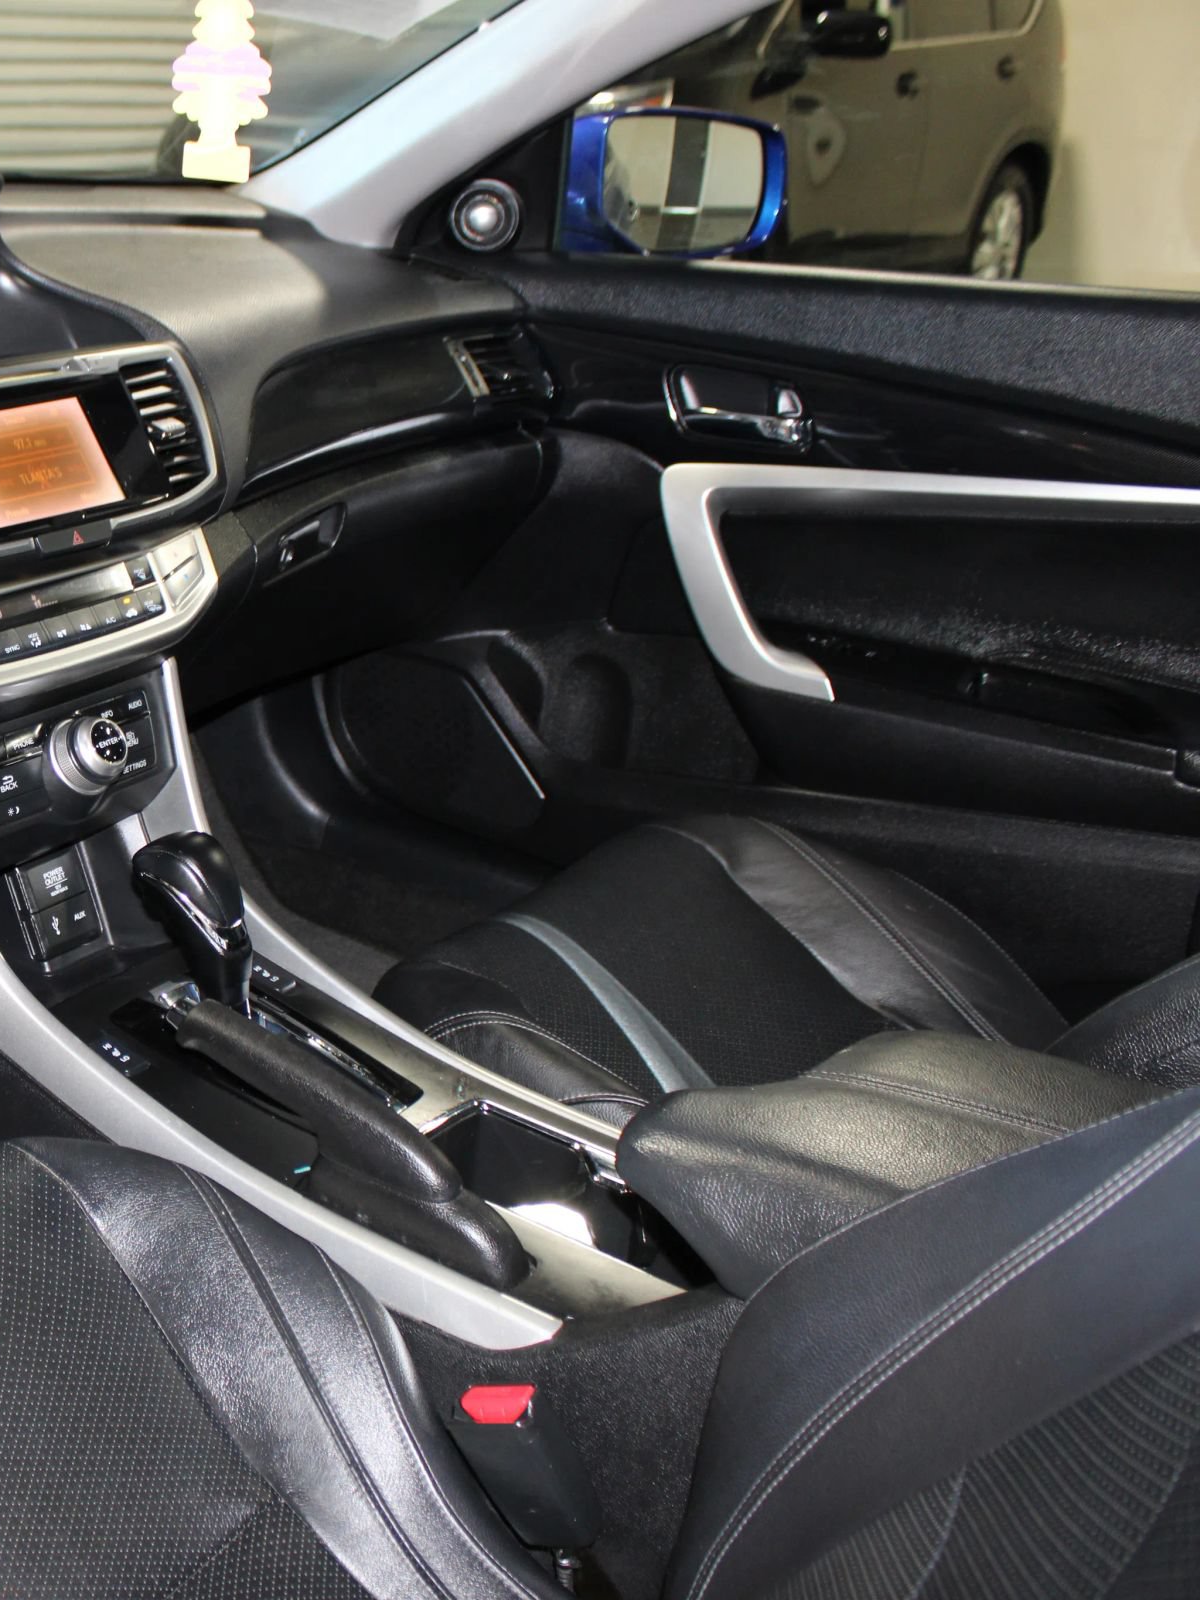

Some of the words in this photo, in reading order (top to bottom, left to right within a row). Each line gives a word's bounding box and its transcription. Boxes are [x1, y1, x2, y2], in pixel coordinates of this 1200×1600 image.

[4, 644, 21, 655] SYNC
[128, 699, 143, 711] AUDIO
[12, 737, 35, 751] PHONE
[99, 735, 119, 749] ENTER
[0, 781, 19, 794] BACK
[42, 866, 64, 880] POWER
[44, 872, 66, 887] OUTLET
[73, 910, 87, 922] AUX
